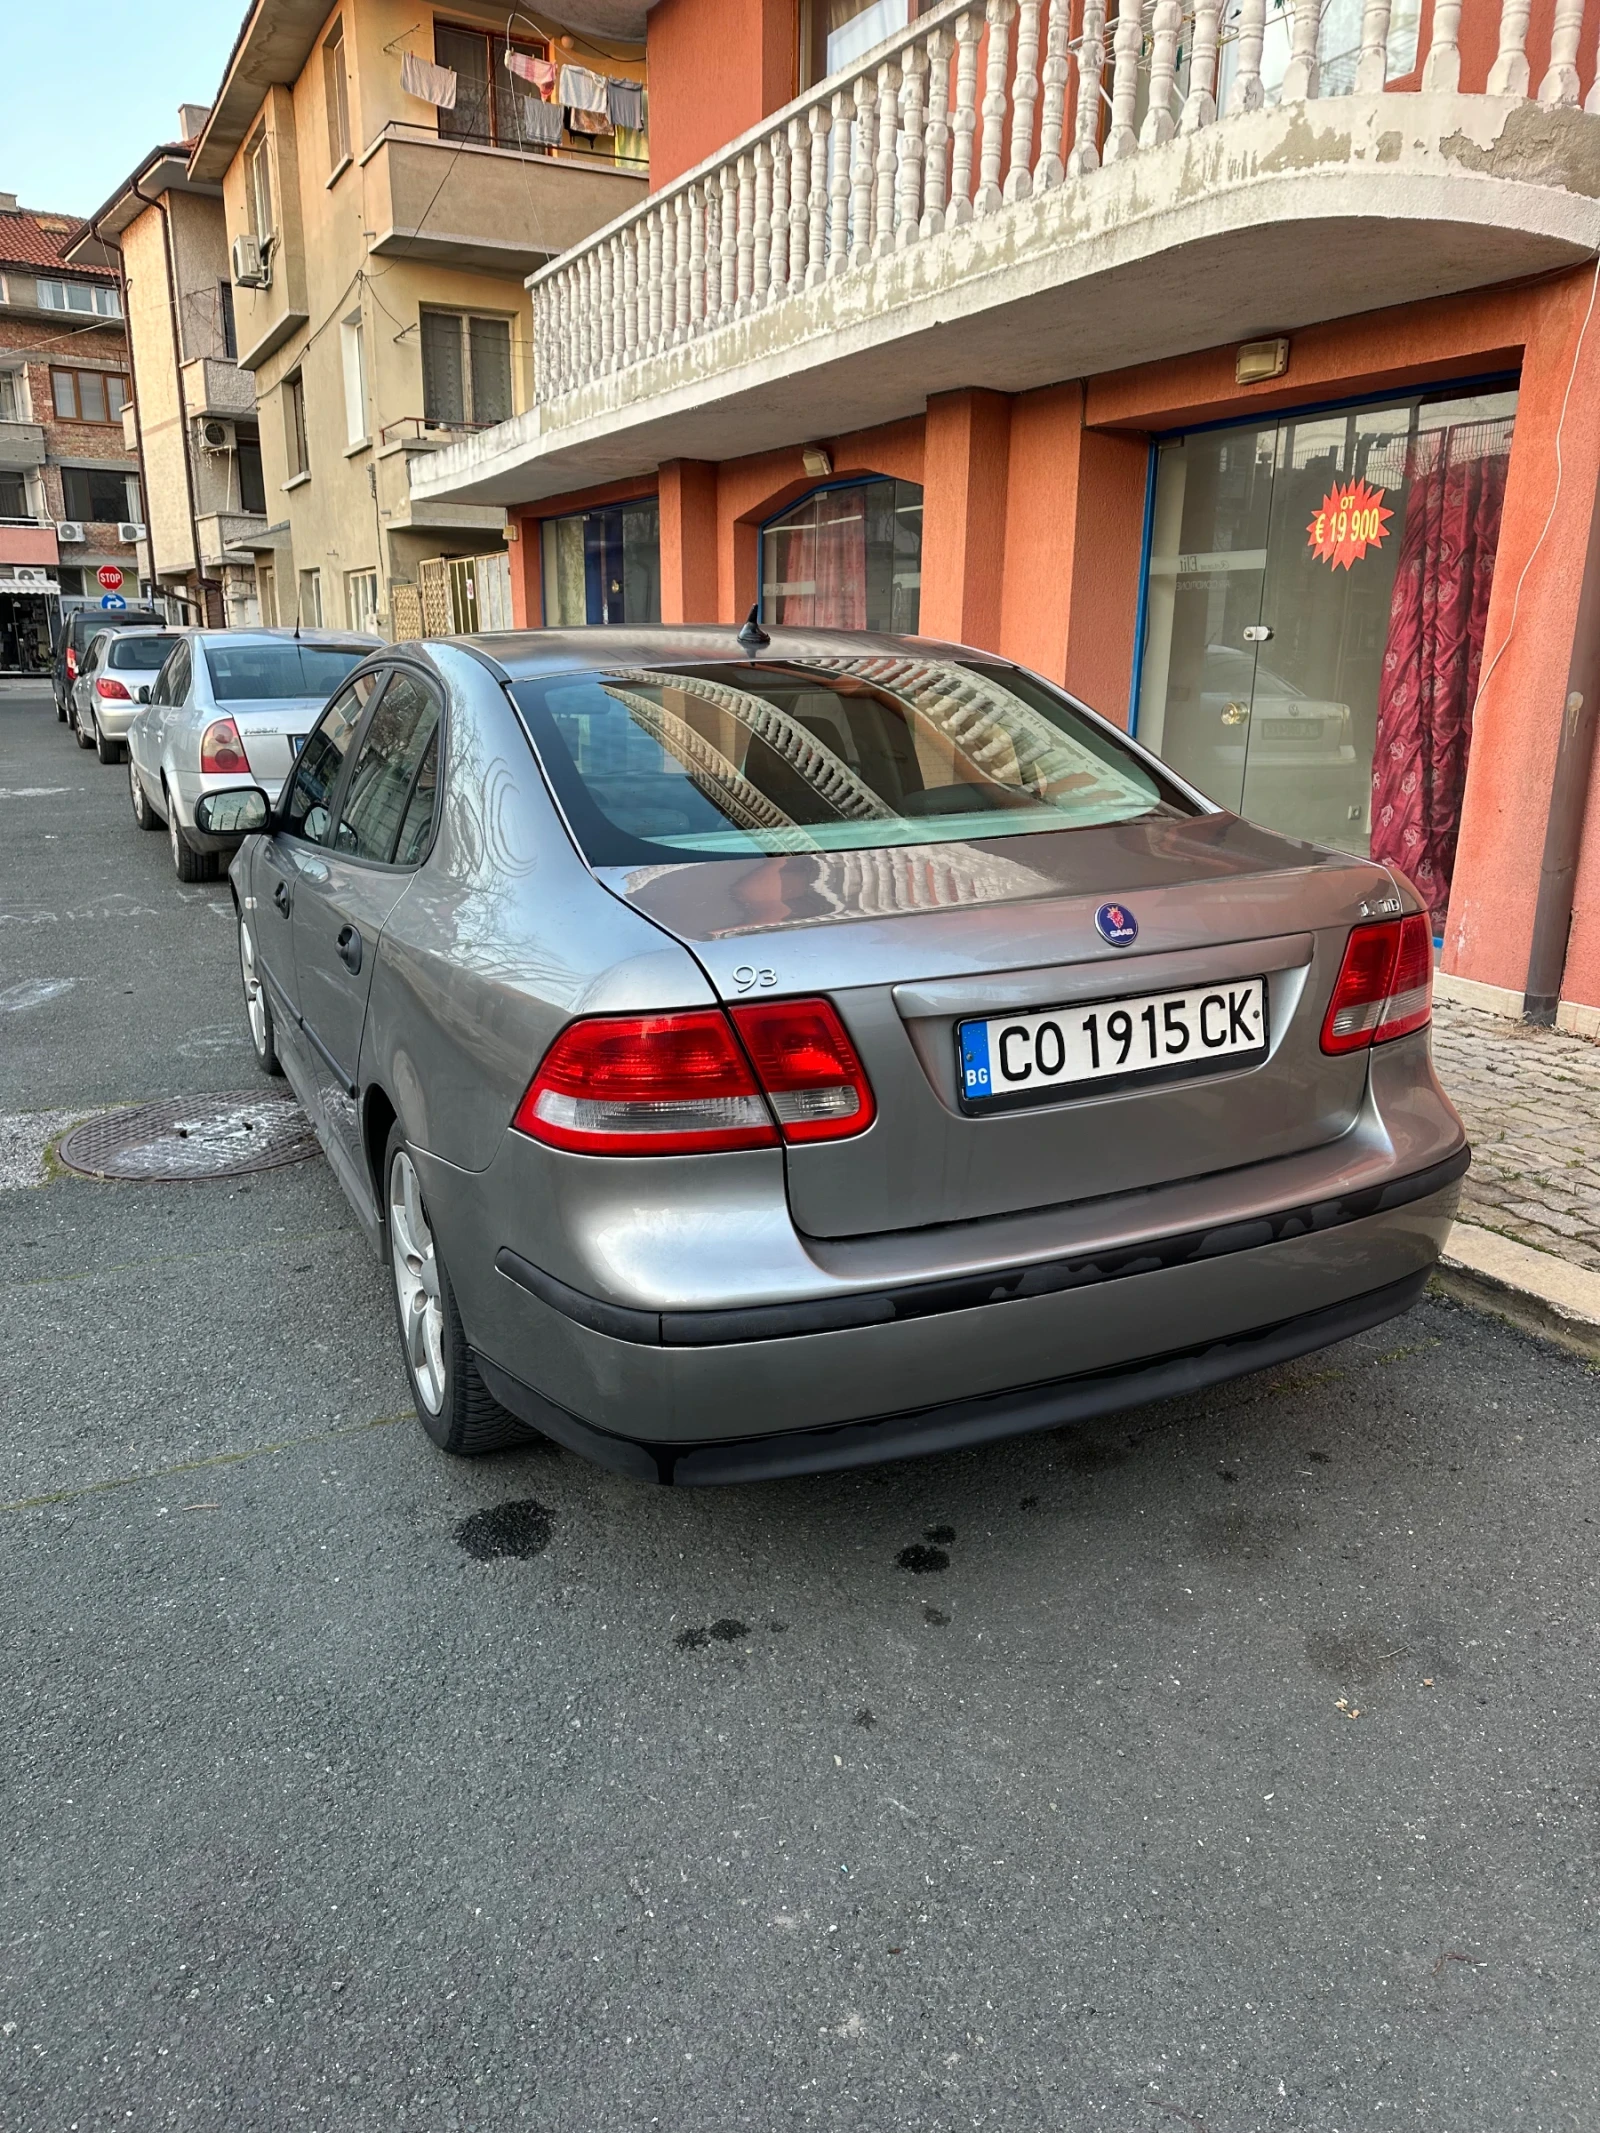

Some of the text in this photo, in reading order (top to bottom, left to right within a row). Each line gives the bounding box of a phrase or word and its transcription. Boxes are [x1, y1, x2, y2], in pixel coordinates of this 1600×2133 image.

[1340, 495, 1356, 510] ОТ
[1315, 507, 1379, 544] € 19 900
[100, 572, 121, 584] STOP
[1110, 928, 1134, 938] SAAB
[998, 988, 1256, 1082] CO 1915 CK
[966, 1067, 989, 1087] BG
